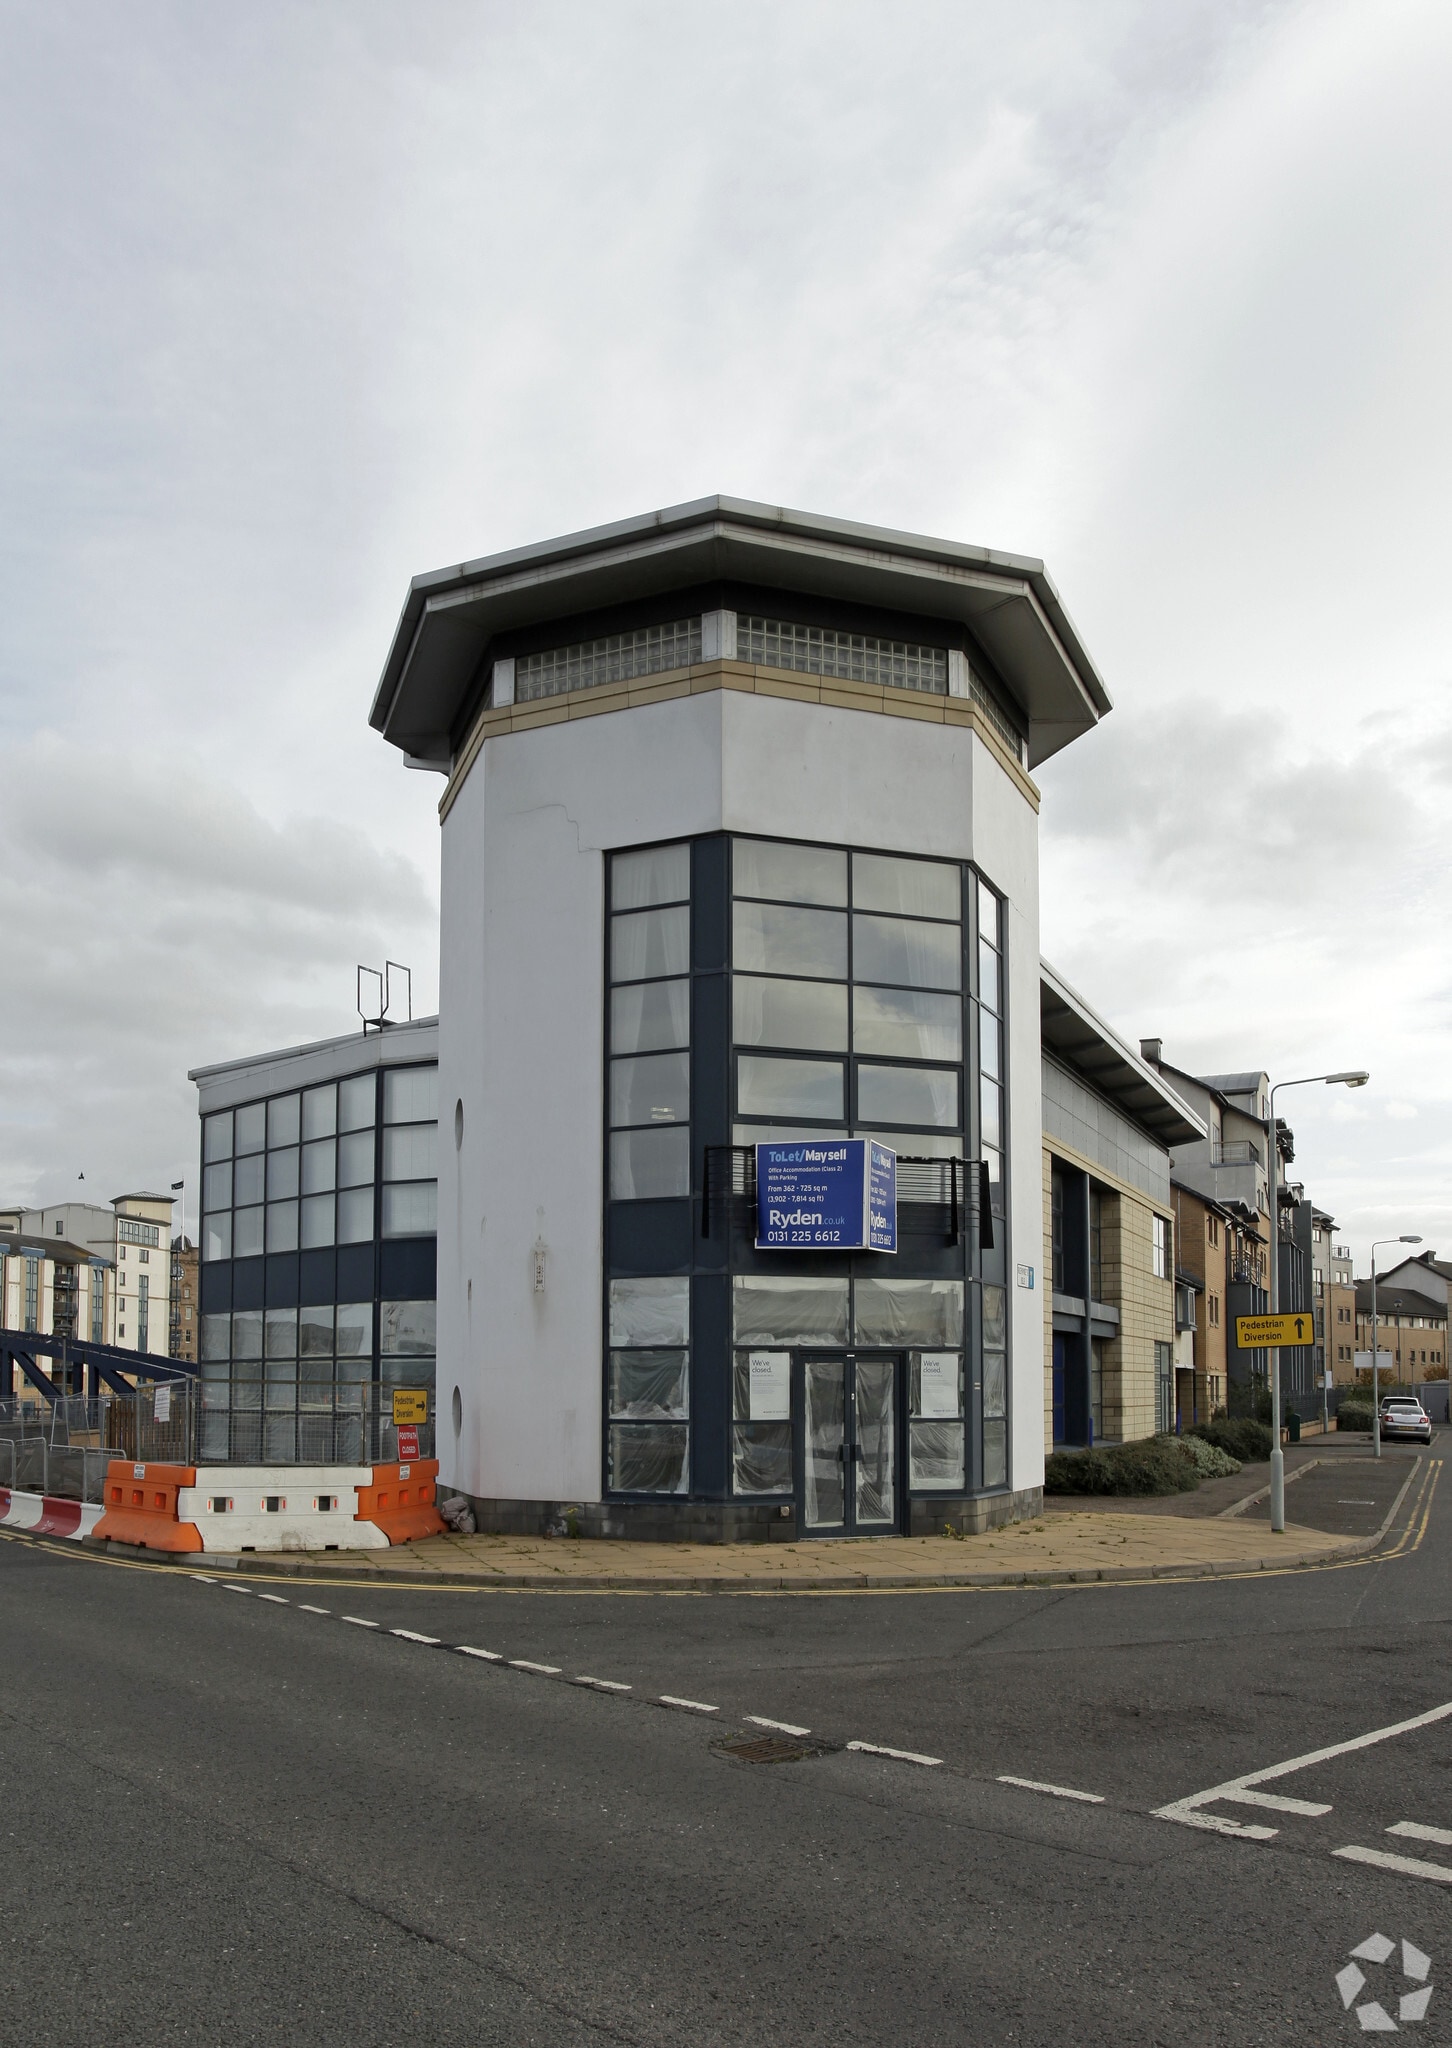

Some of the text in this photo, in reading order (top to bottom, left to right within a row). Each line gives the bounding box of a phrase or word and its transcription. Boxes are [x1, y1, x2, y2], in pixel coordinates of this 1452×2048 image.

[800, 1184, 812, 1192] 725
[791, 1195, 807, 1203] 7,814
[816, 1195, 824, 1203] ft)
[767, 1230, 841, 1242] 0131 225 6612
[1240, 1319, 1284, 1330] Pedestrian
[1244, 1331, 1282, 1342] Diversion
[395, 1396, 415, 1405] Pedestrian
[396, 1409, 414, 1418] Diversion
